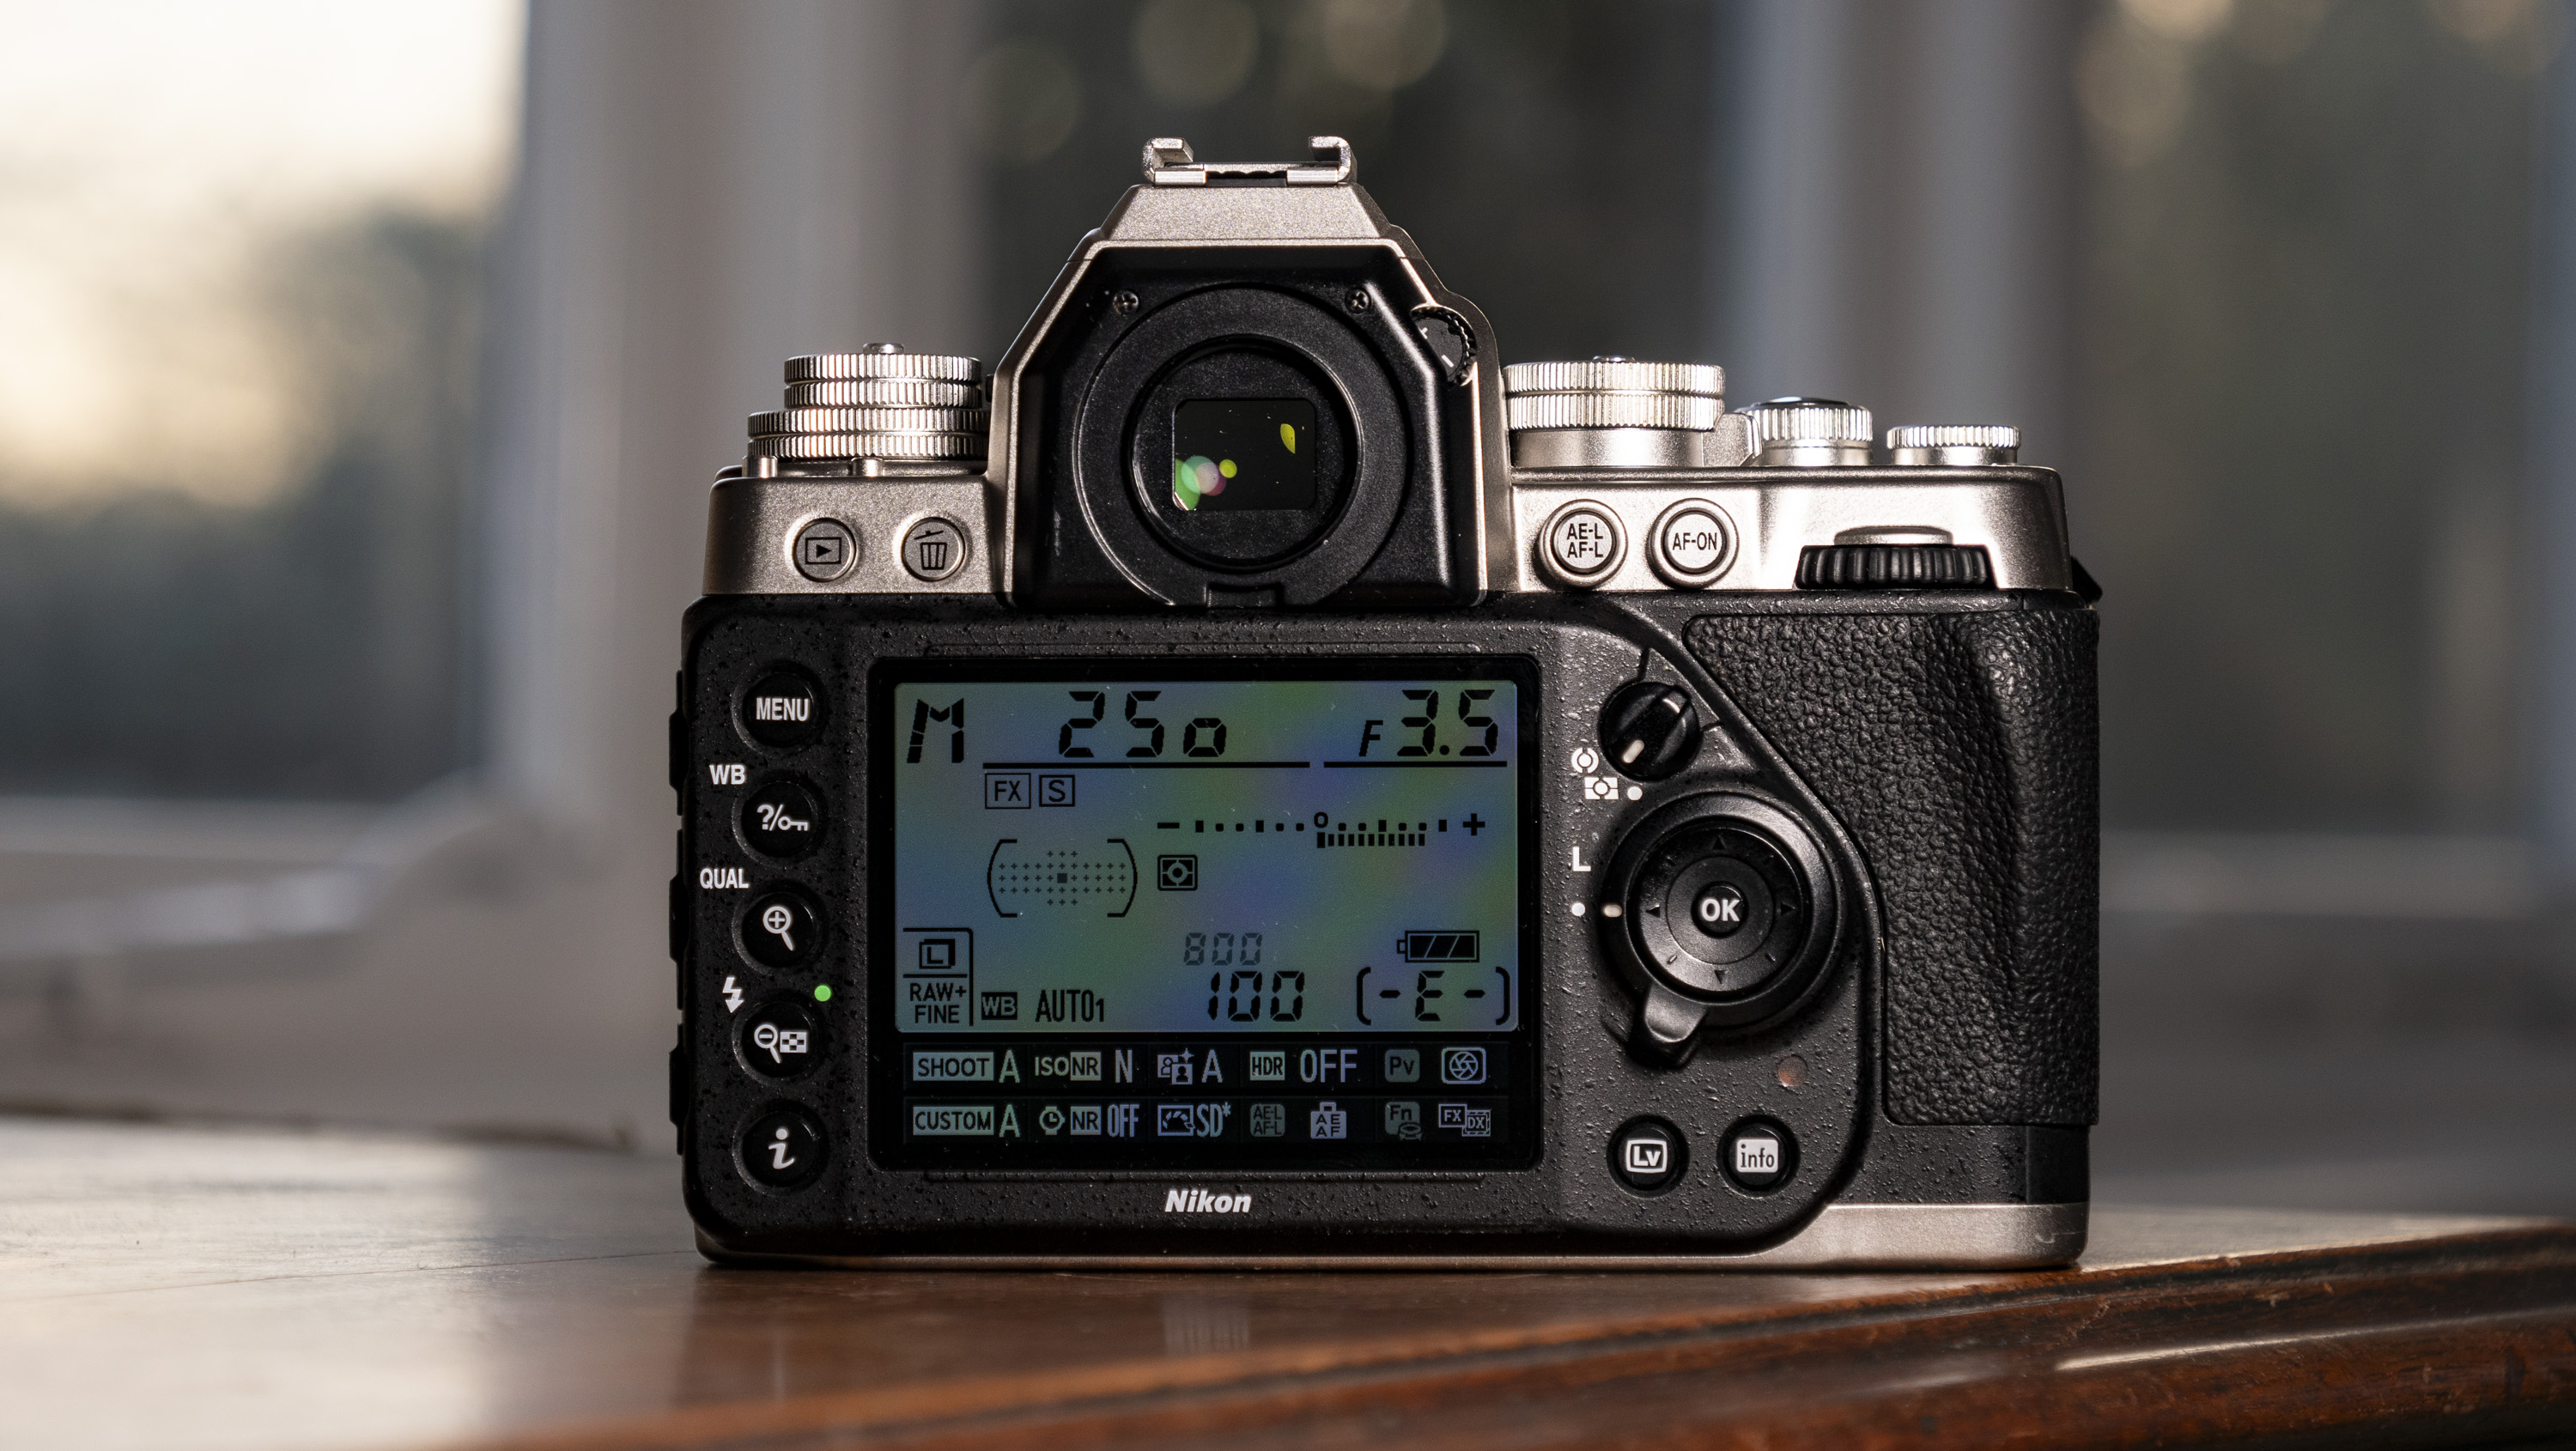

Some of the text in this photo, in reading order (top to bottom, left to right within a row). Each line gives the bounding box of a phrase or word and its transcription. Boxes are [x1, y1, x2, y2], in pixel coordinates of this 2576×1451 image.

[1566, 523, 1604, 540] AE-L
[1673, 531, 1718, 550] AF-ON
[1566, 541, 1604, 558] AF-L
[756, 697, 810, 722] MENU
[907, 697, 964, 763] M
[709, 763, 746, 786] WB
[993, 779, 1066, 803] FX S
[1572, 846, 1591, 872] L
[699, 867, 750, 889] QUAL
[1700, 898, 1741, 923] OK
[1184, 932, 1262, 966] 800
[909, 982, 967, 1002] RAW+
[1207, 970, 1304, 1022] 100
[914, 1005, 960, 1023] FINE
[981, 996, 1016, 1017] WB
[917, 1049, 1020, 1084] SHOOT A
[1035, 1056, 1100, 1077] ISO NR
[1115, 1049, 1133, 1084] N
[1201, 1048, 1224, 1084] A
[1251, 1048, 1358, 1084] HDR OFF
[1389, 1056, 1415, 1076] Pv
[914, 1103, 1020, 1138] CUSTOM A
[1073, 1103, 1140, 1138] NR OFF
[1389, 1105, 1413, 1121] Fn
[1444, 1109, 1462, 1122] FX
[1467, 1117, 1485, 1129] DX
[1633, 1145, 1662, 1167] Lv
[1740, 1144, 1775, 1169] info
[1164, 1189, 1252, 1213] Nikon
